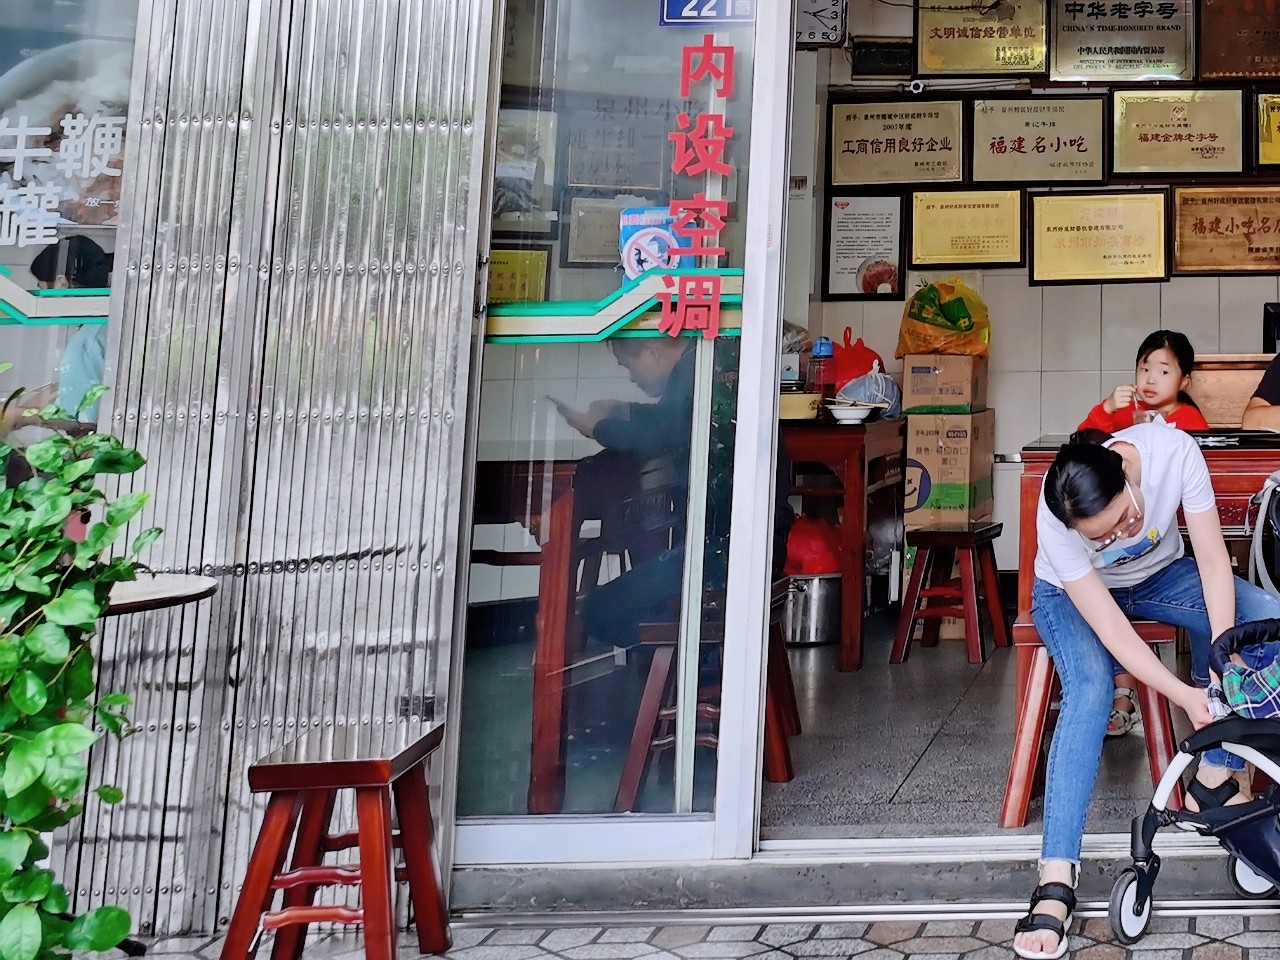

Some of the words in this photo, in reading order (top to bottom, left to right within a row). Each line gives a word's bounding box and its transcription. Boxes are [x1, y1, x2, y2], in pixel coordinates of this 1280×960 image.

[1064, 1, 1178, 21] 中华老字号
[930, 26, 1036, 39] 文明诚信经营单位
[0, 113, 126, 181] 牛鞭
[842, 136, 952, 155] 工商信用良好企业
[990, 135, 1088, 154] 福建名小吃
[1138, 133, 1218, 143] 福建金牌老字号
[655, 34, 735, 340] 内设空调
